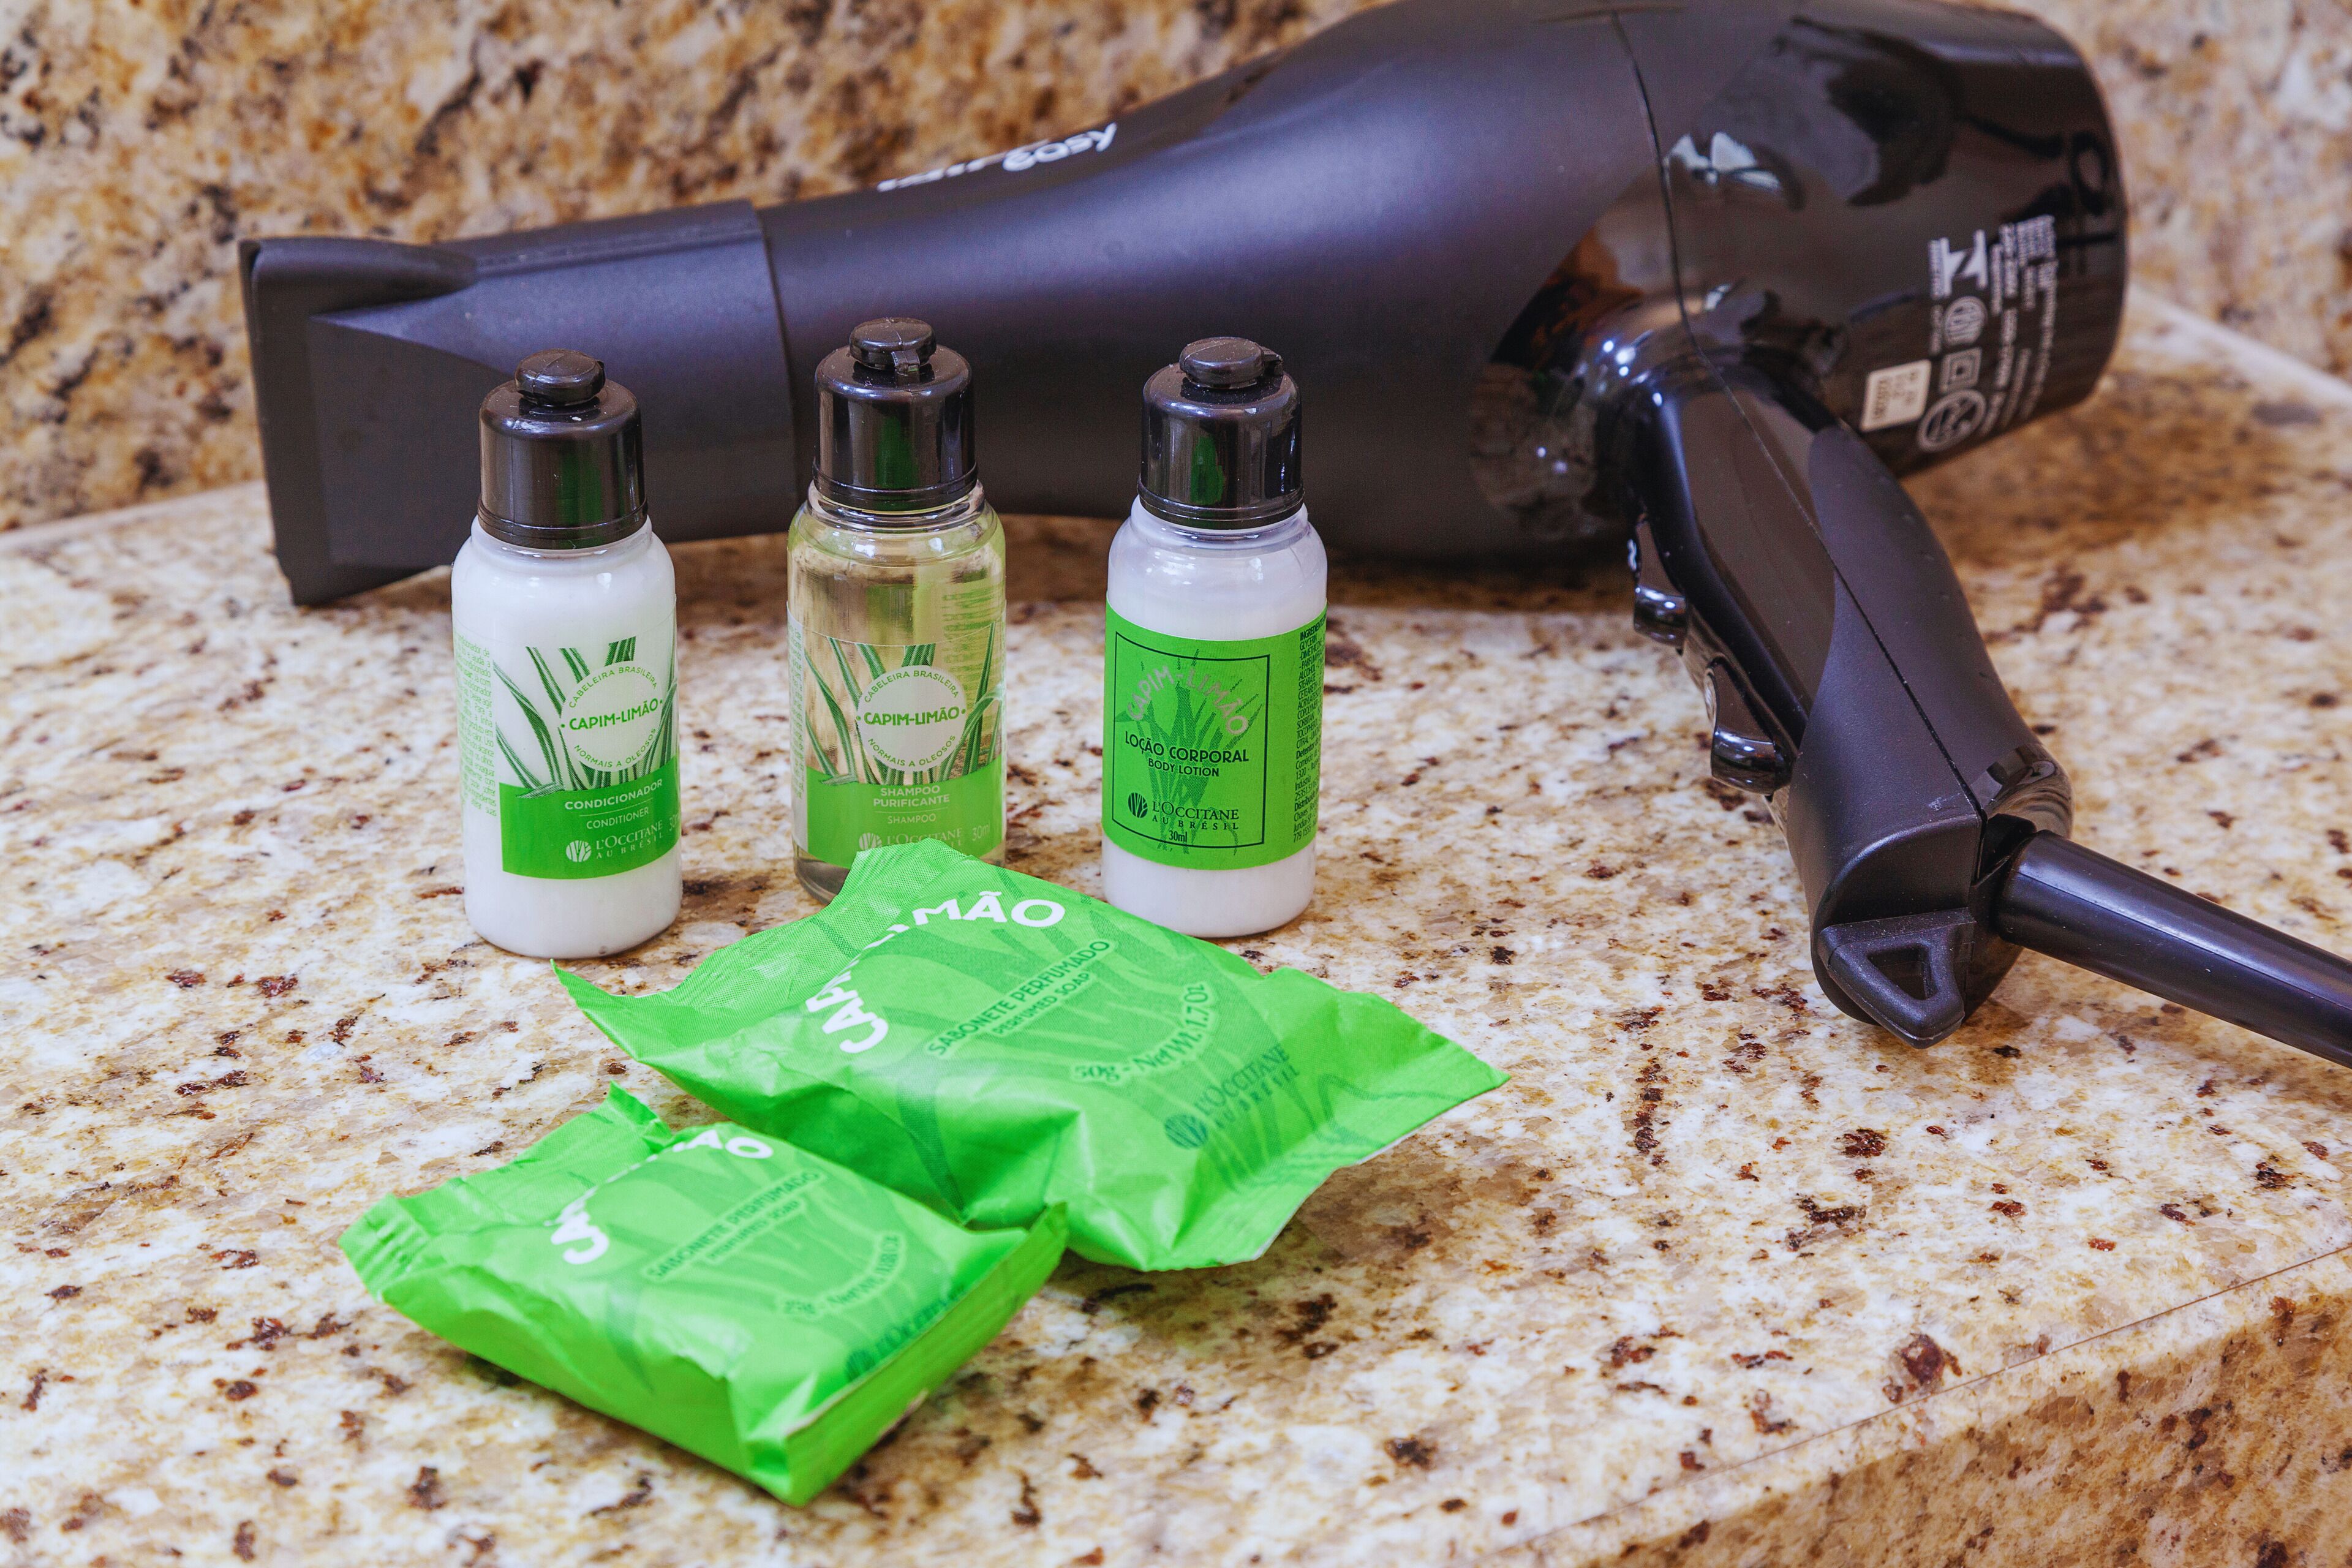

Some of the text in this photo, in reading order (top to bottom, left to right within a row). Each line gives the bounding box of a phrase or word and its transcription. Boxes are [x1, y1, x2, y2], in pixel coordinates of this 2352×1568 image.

[569, 666, 657, 709] CABELEIRA BRASILEIRA
[864, 670, 959, 703] CABELEIRA BRASILEIRA
[569, 698, 658, 731] CAPIM-LIMÃO
[864, 706, 960, 726] CAPIM-LIMÃO
[574, 744, 612, 768] NORMAIS
[625, 728, 656, 764] OLEOSOS
[867, 738, 906, 767] NORMAIS
[919, 735, 956, 766] OLEOSOS
[1125, 730, 1250, 764] LOÇÃO CORPORAL
[1148, 758, 1219, 777] BODY LOTION
[565, 778, 663, 810] CONDICIONADOR
[873, 793, 950, 808] PURIFICANTE
[880, 785, 941, 797] SHAMPOO
[586, 806, 649, 829] CONDITIONER
[887, 813, 937, 824] SHAMPOO
[1152, 801, 1240, 821] L'OCCITANE
[595, 820, 663, 850] L'OCCITANE
[1169, 829, 1188, 843] 30ml
[1054, 971, 1090, 996] SOAP
[928, 941, 1110, 1056] SABONETE PERFUMADO
